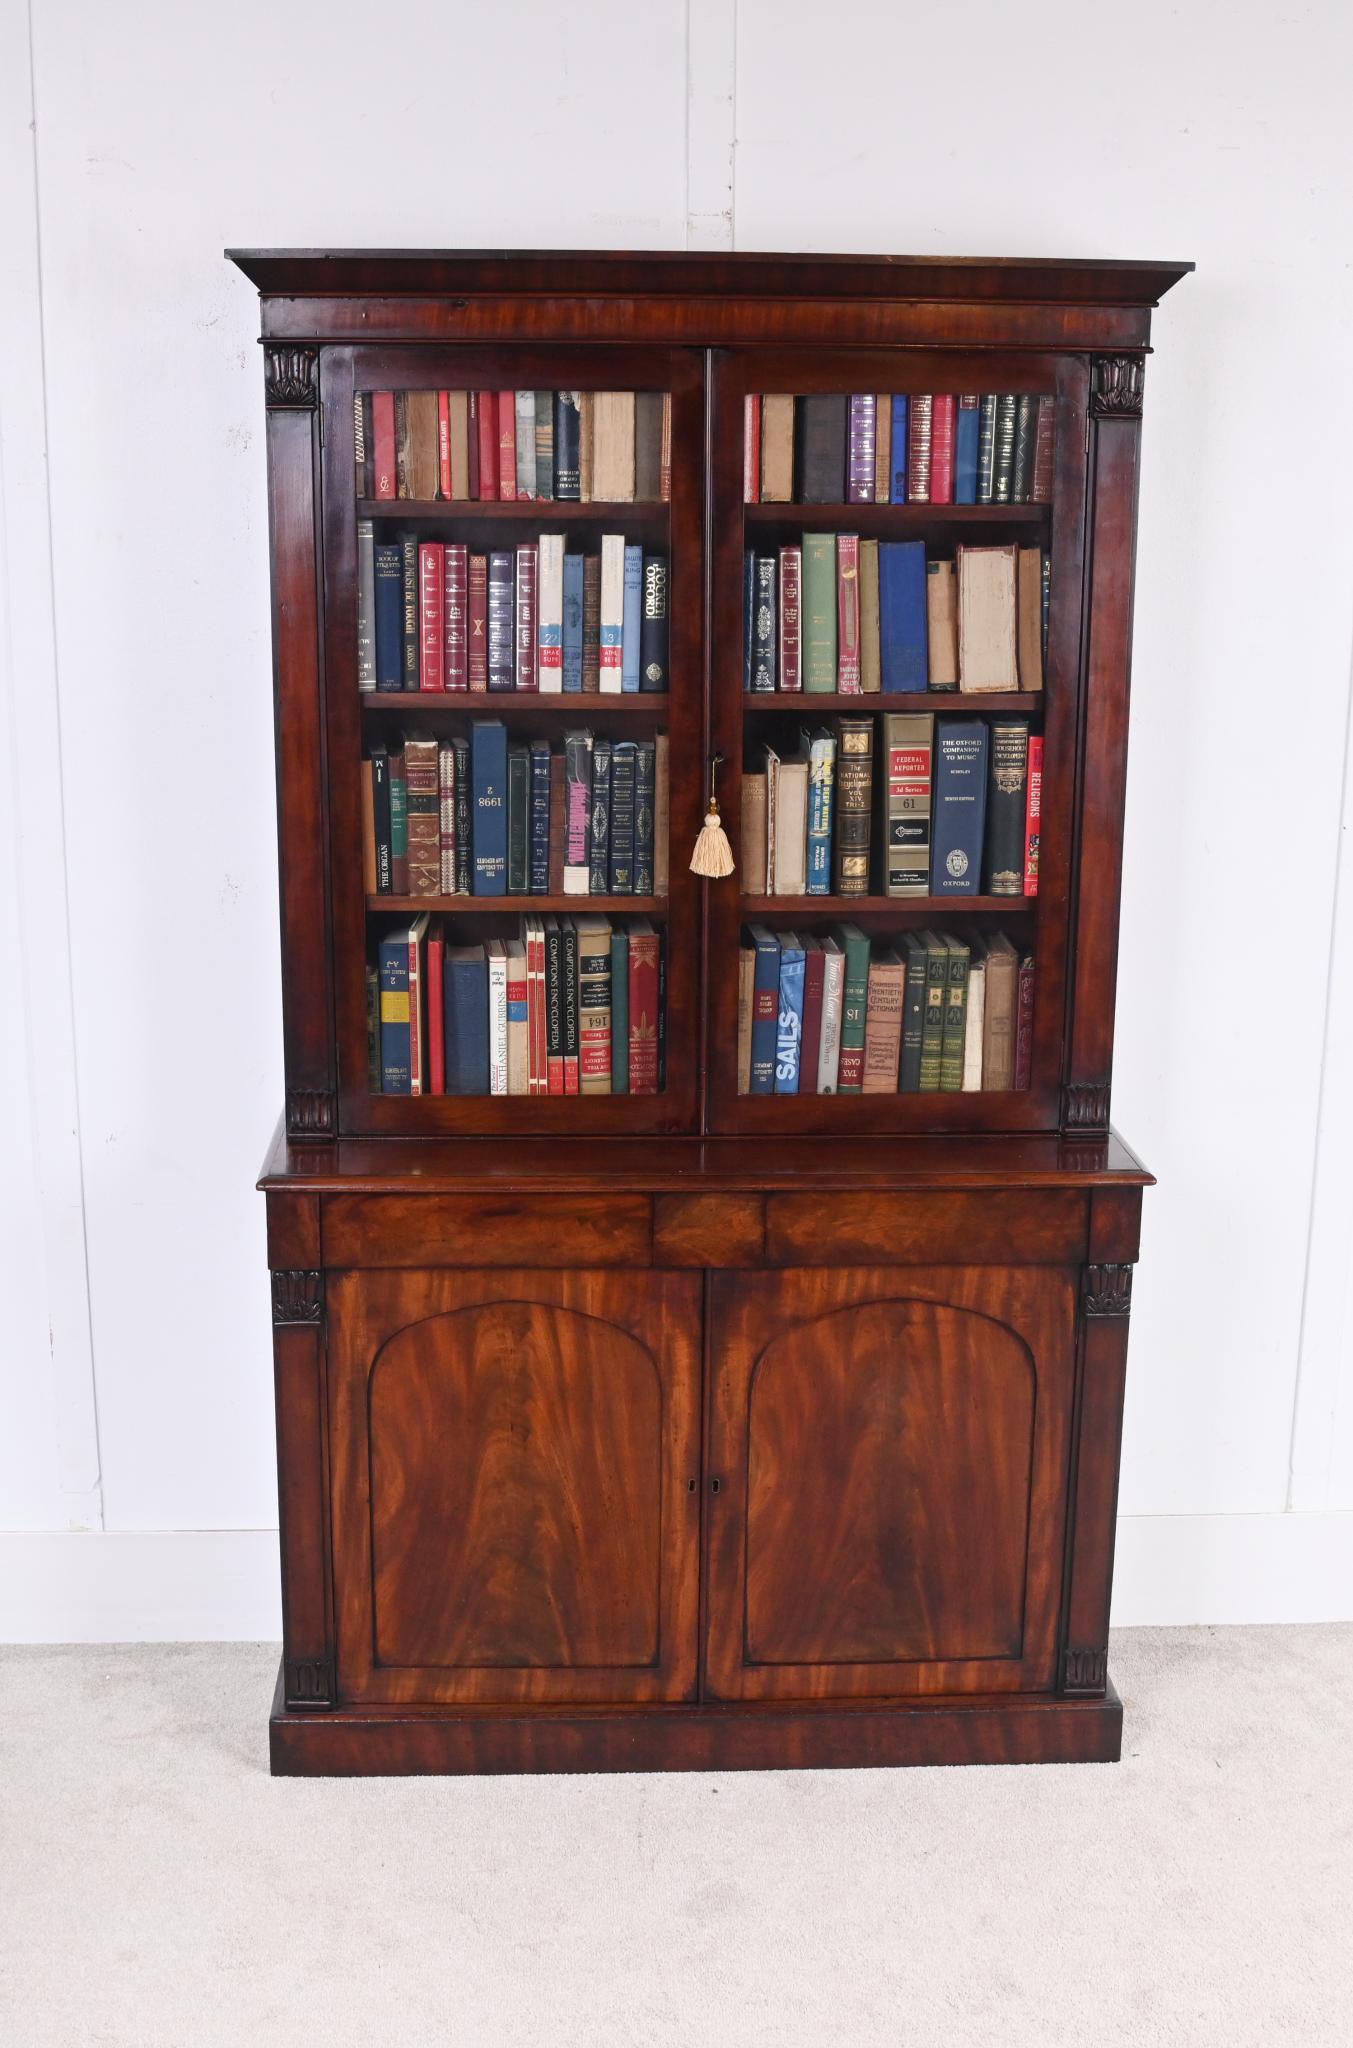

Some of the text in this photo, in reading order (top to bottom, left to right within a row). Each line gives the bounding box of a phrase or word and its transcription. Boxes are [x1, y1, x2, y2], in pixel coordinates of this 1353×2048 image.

[440, 419, 448, 441] PLANTS
[404, 542, 416, 634] LOVE MUST BE TOUGH
[645, 565, 656, 617] OXFORD
[655, 567, 666, 614] POCKET
[607, 633, 614, 643] 3
[406, 645, 415, 671] DOBSON
[894, 764, 925, 772] REPORTER
[478, 797, 502, 807] 1998
[487, 786, 493, 795] 2
[822, 786, 830, 804] DEEP
[1030, 771, 1041, 818] RELIGIONS
[903, 798, 916, 809] 61
[380, 844, 388, 871] ORGAN
[390, 976, 396, 985] 2
[550, 937, 559, 1050] COMPTON'S ENCYCLOPEDIA
[826, 981, 840, 1019] Moore
[870, 996, 899, 1005] CENTURY
[567, 988, 575, 1050] ENCYCLOPEDIA
[589, 1015, 608, 1027] 164
[846, 1008, 859, 1020] 18
[497, 991, 507, 1092] NATHANIEL GUBBINS
[776, 1010, 800, 1081] SAILS
